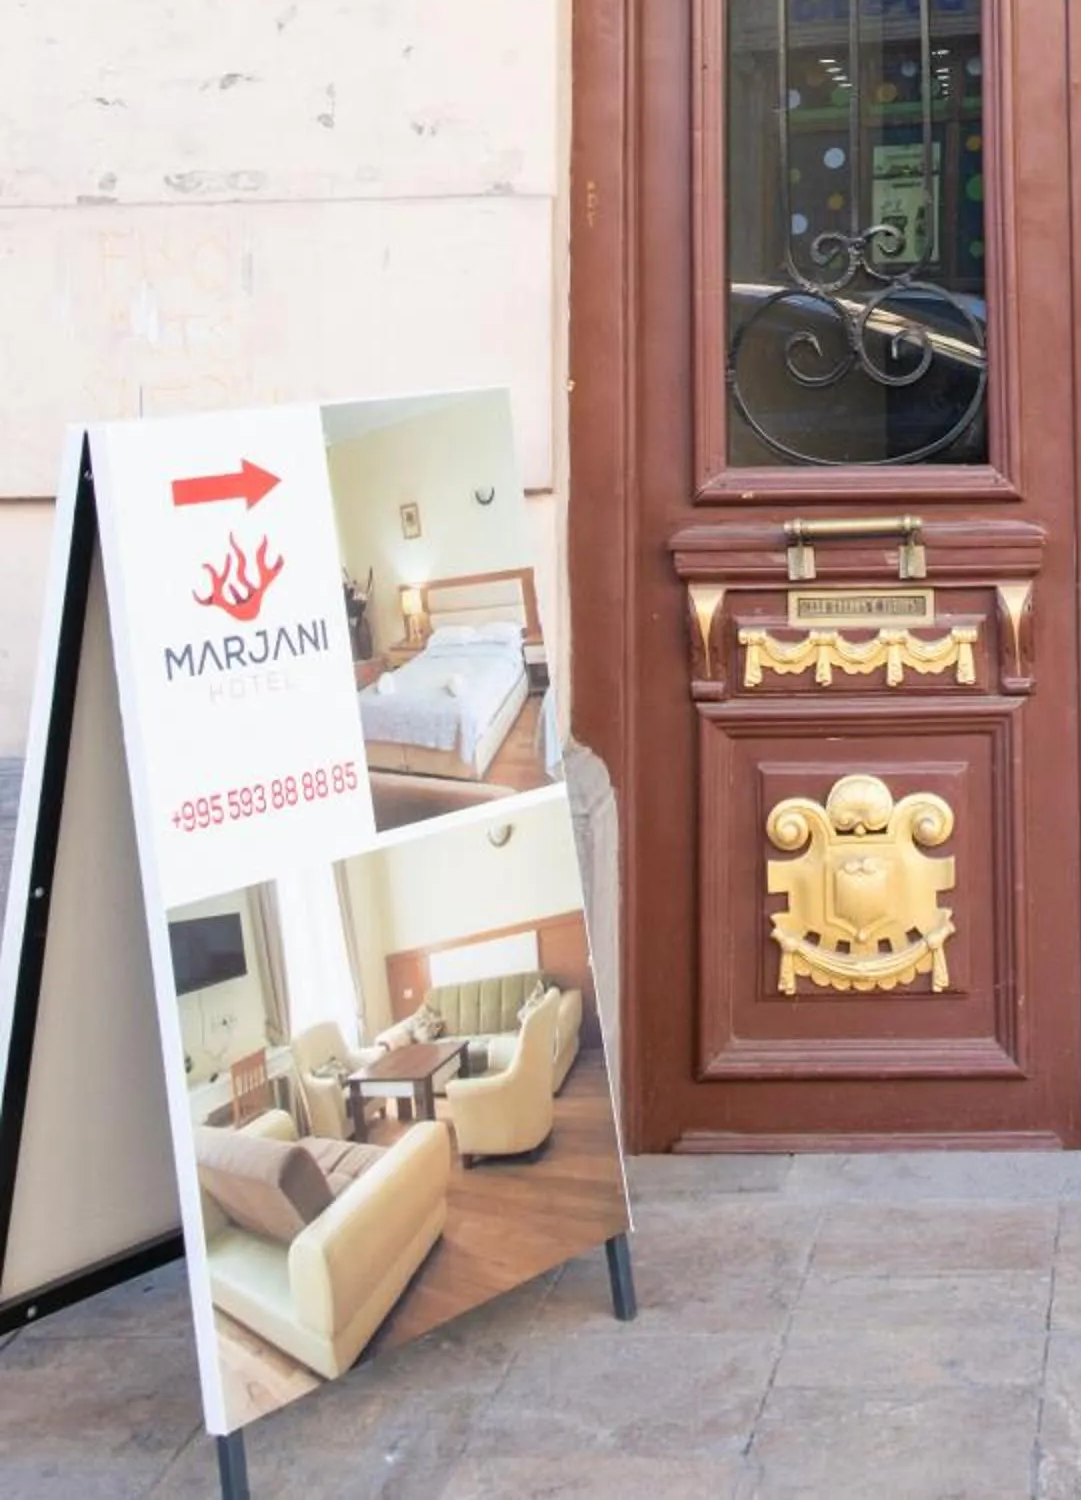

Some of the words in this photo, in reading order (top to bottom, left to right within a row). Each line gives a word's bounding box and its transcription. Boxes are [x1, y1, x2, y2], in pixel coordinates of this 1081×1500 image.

[163, 617, 330, 682] MARJANI
[208, 672, 297, 704] HOTEL
[171, 795, 225, 832] +995
[227, 784, 268, 820] 593
[270, 775, 299, 810] 88
[301, 768, 329, 801] 88
[331, 761, 358, 794] 85
